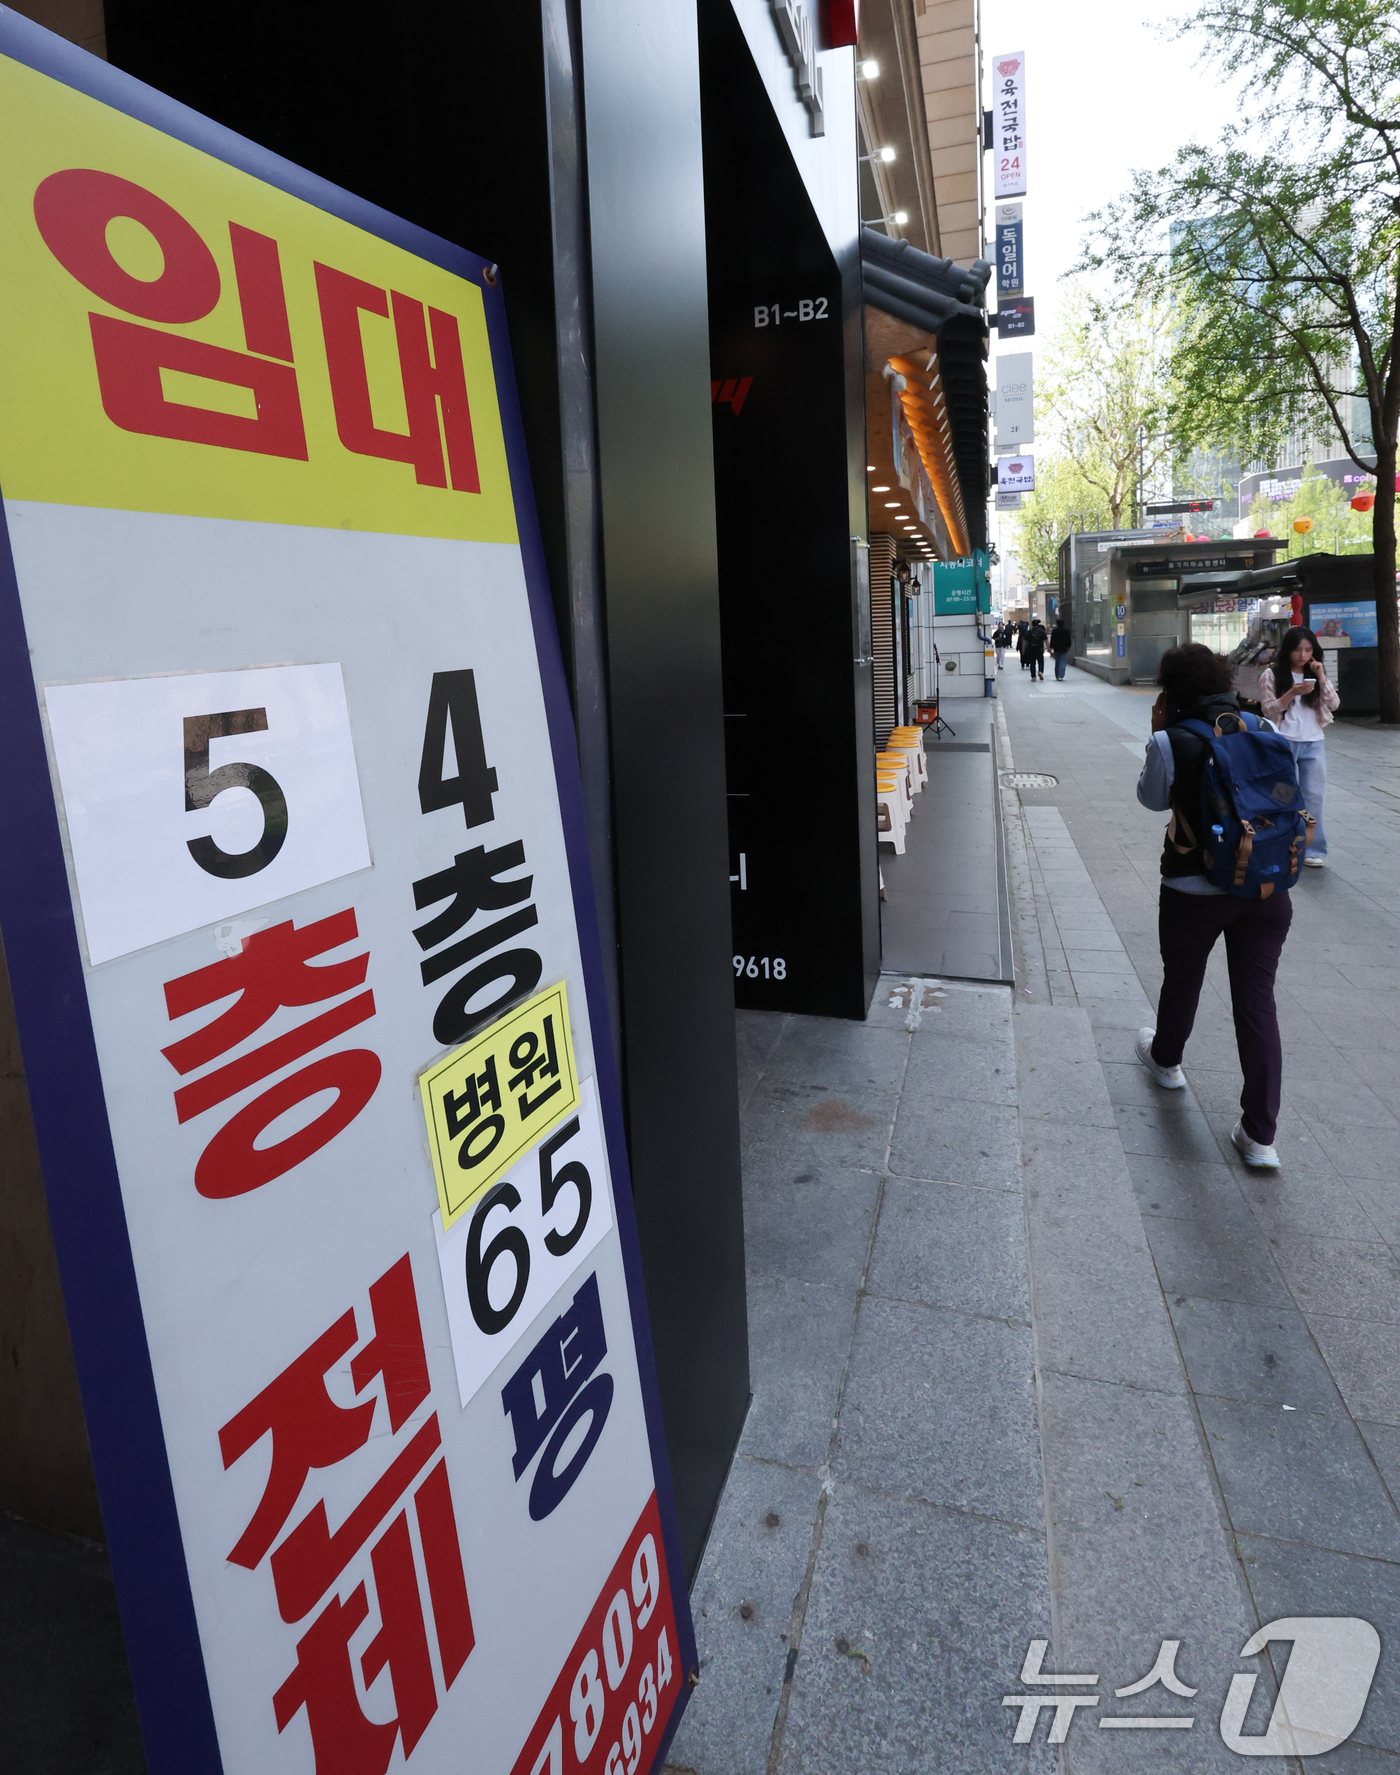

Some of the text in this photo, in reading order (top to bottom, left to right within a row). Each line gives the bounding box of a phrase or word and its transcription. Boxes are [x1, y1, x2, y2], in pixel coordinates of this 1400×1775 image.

[1001, 78, 1022, 152] 육전국밥
[1001, 156, 1021, 171] 24
[1001, 171, 1021, 181] OPEN
[1002, 228, 1017, 277] 독일어
[1002, 278, 1019, 288] 학원
[754, 297, 829, 328] B1~B2
[33, 168, 481, 494] 임대
[1001, 381, 1027, 394] ciee
[1010, 425, 1020, 433] 2F
[1000, 476, 1032, 485] 육전국밥
[1116, 605, 1126, 616] 10
[1215, 598, 1237, 613] 도장
[732, 954, 787, 981] 9618
[443, 1013, 564, 1170] 병원
